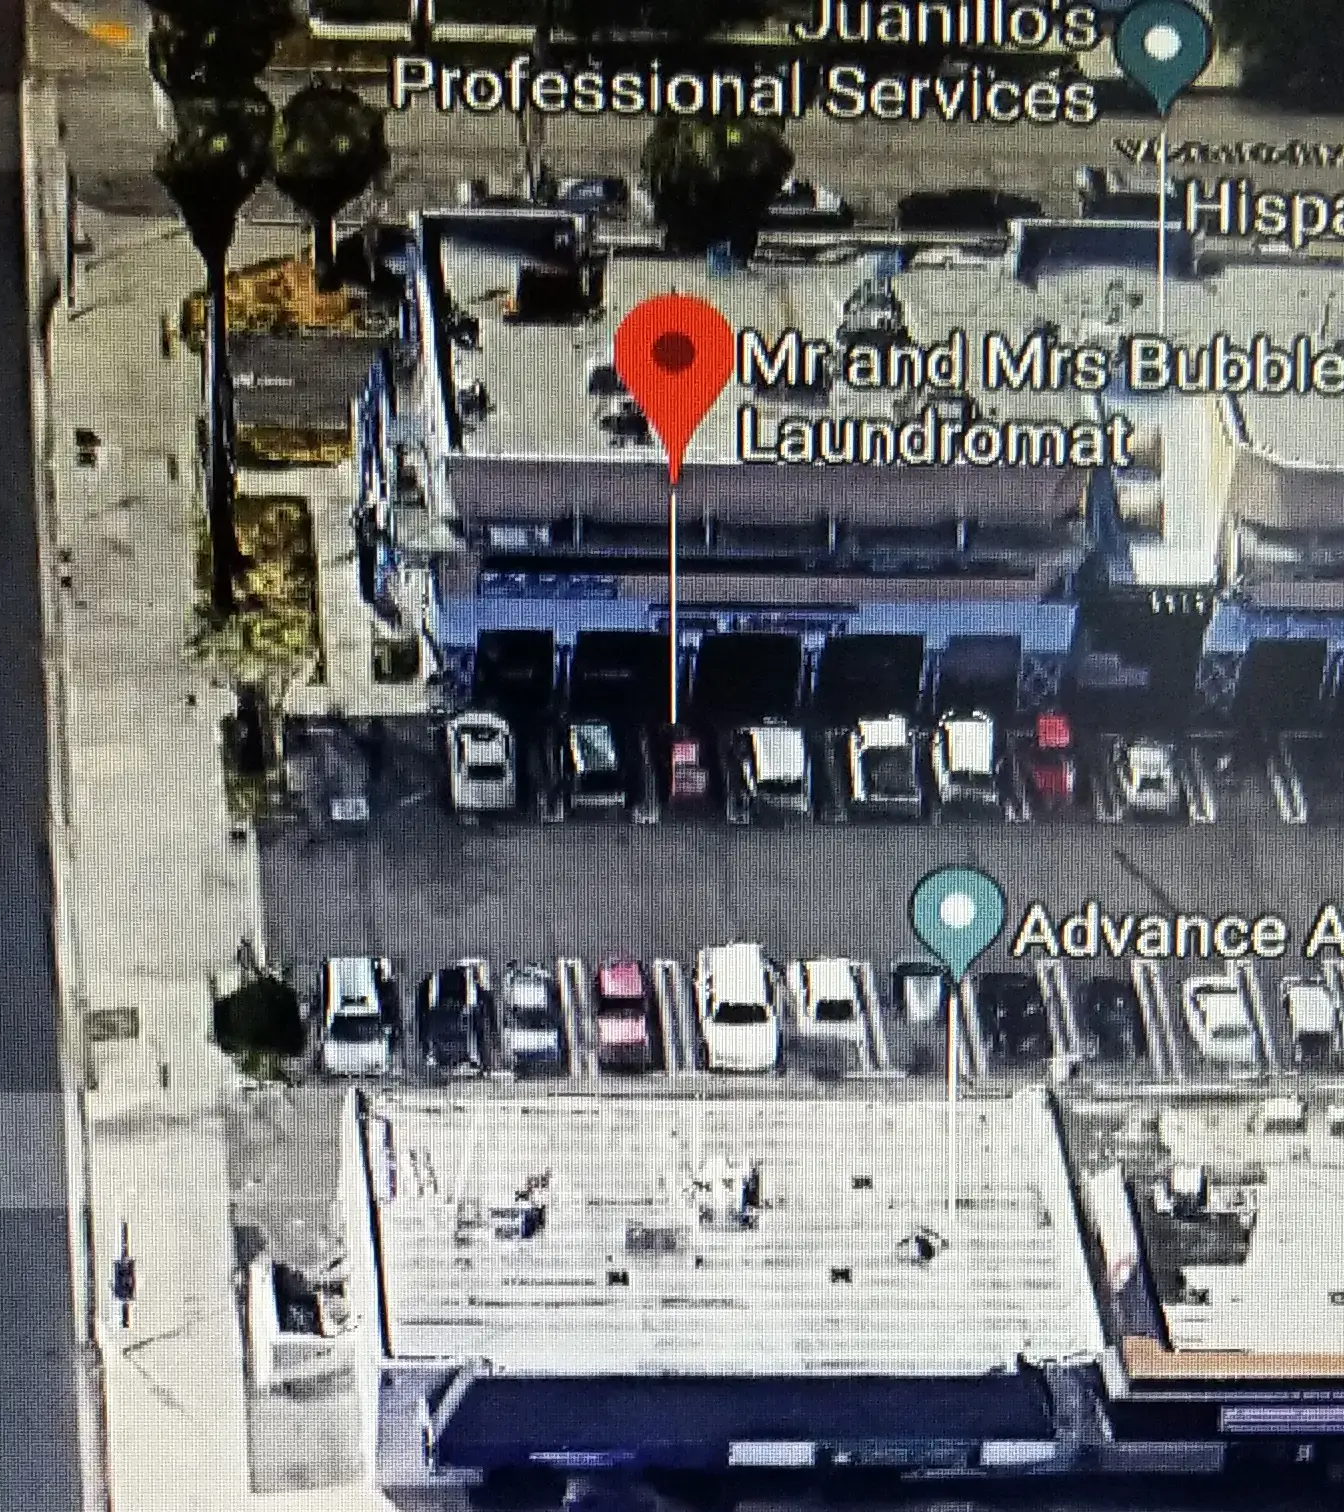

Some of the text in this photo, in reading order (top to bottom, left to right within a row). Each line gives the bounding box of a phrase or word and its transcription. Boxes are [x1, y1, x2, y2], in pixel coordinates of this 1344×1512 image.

[392, 56, 1098, 122] Professional Services
[737, 330, 826, 387] Mr
[847, 330, 963, 388] and
[986, 333, 1108, 391] Mrs
[737, 405, 1132, 466] Laundromat
[1013, 903, 1287, 959] Advance
